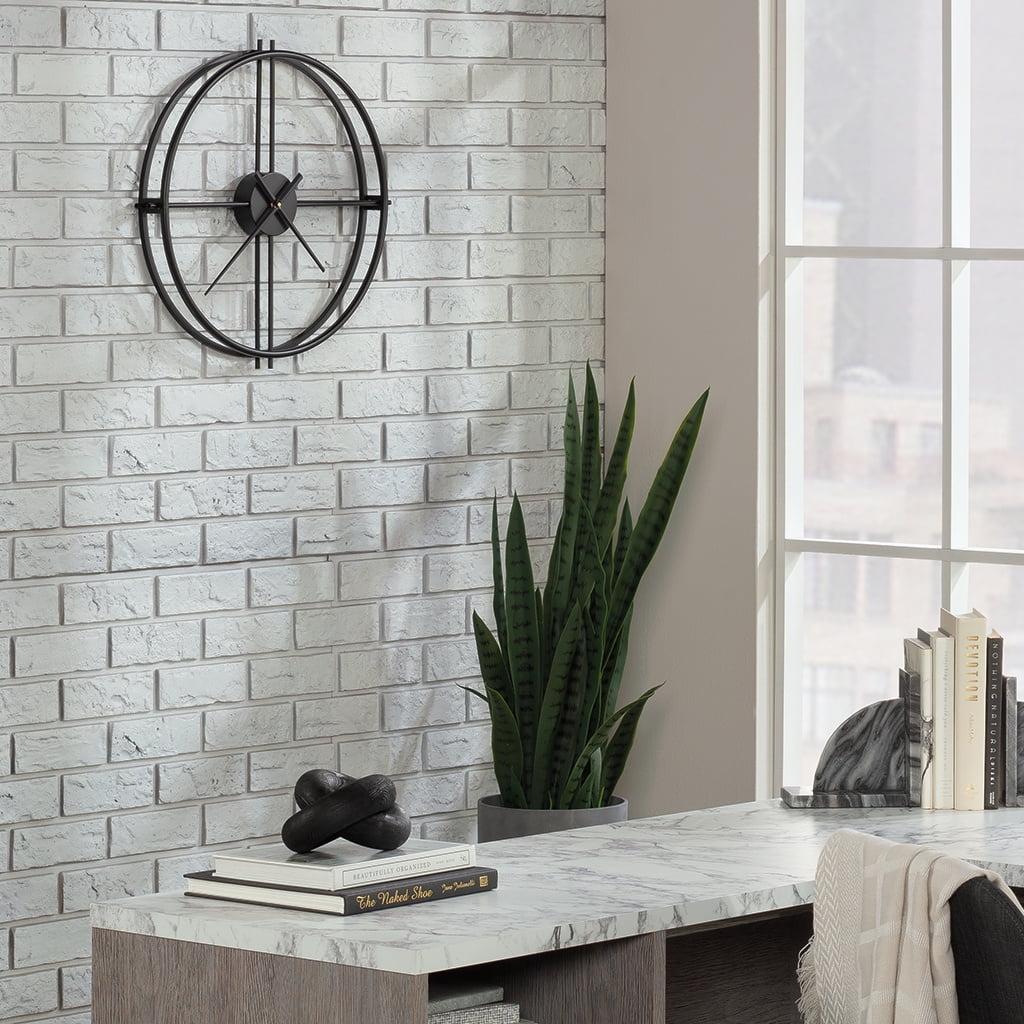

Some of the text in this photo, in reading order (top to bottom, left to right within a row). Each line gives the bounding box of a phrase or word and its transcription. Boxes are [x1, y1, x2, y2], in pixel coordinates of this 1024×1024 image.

[964, 635, 979, 703] DEVOTION
[989, 642, 999, 761] NOTHING NATURAL
[353, 867, 394, 880] BEAUTIFULLY
[395, 861, 432, 874] ORGANIZED
[356, 885, 434, 909] The Naked Shoe
